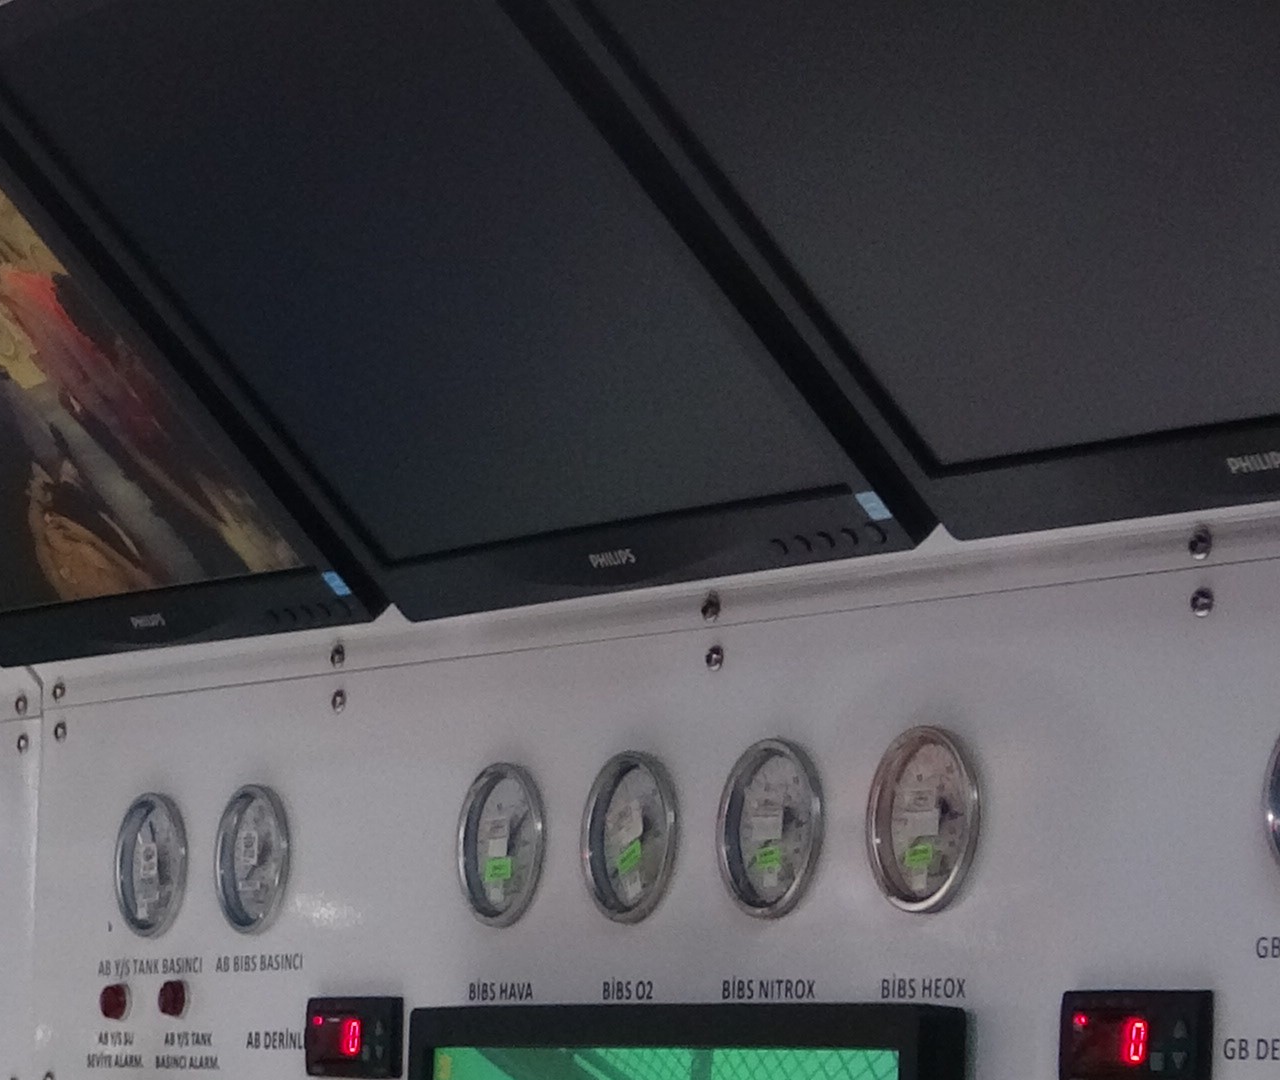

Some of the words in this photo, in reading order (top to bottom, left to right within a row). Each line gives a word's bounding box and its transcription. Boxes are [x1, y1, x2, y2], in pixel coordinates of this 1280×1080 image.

[588, 548, 637, 569] PHILIPS
[98, 960, 111, 976] AB
[133, 958, 159, 975] TANK
[216, 956, 230, 973] AB
[469, 978, 496, 1001] BİBS
[499, 982, 534, 1000] HAVA
[602, 977, 632, 1000] BİBS
[722, 975, 754, 1000] BİBS
[758, 979, 816, 1000] NITROX
[881, 973, 915, 999] BİBS
[921, 978, 966, 999] HEOX
[191, 1032, 213, 1046] TANK
[246, 1033, 260, 1049] AB
[1129, 1020, 1146, 1062] 0
[1224, 1039, 1249, 1060] GB
